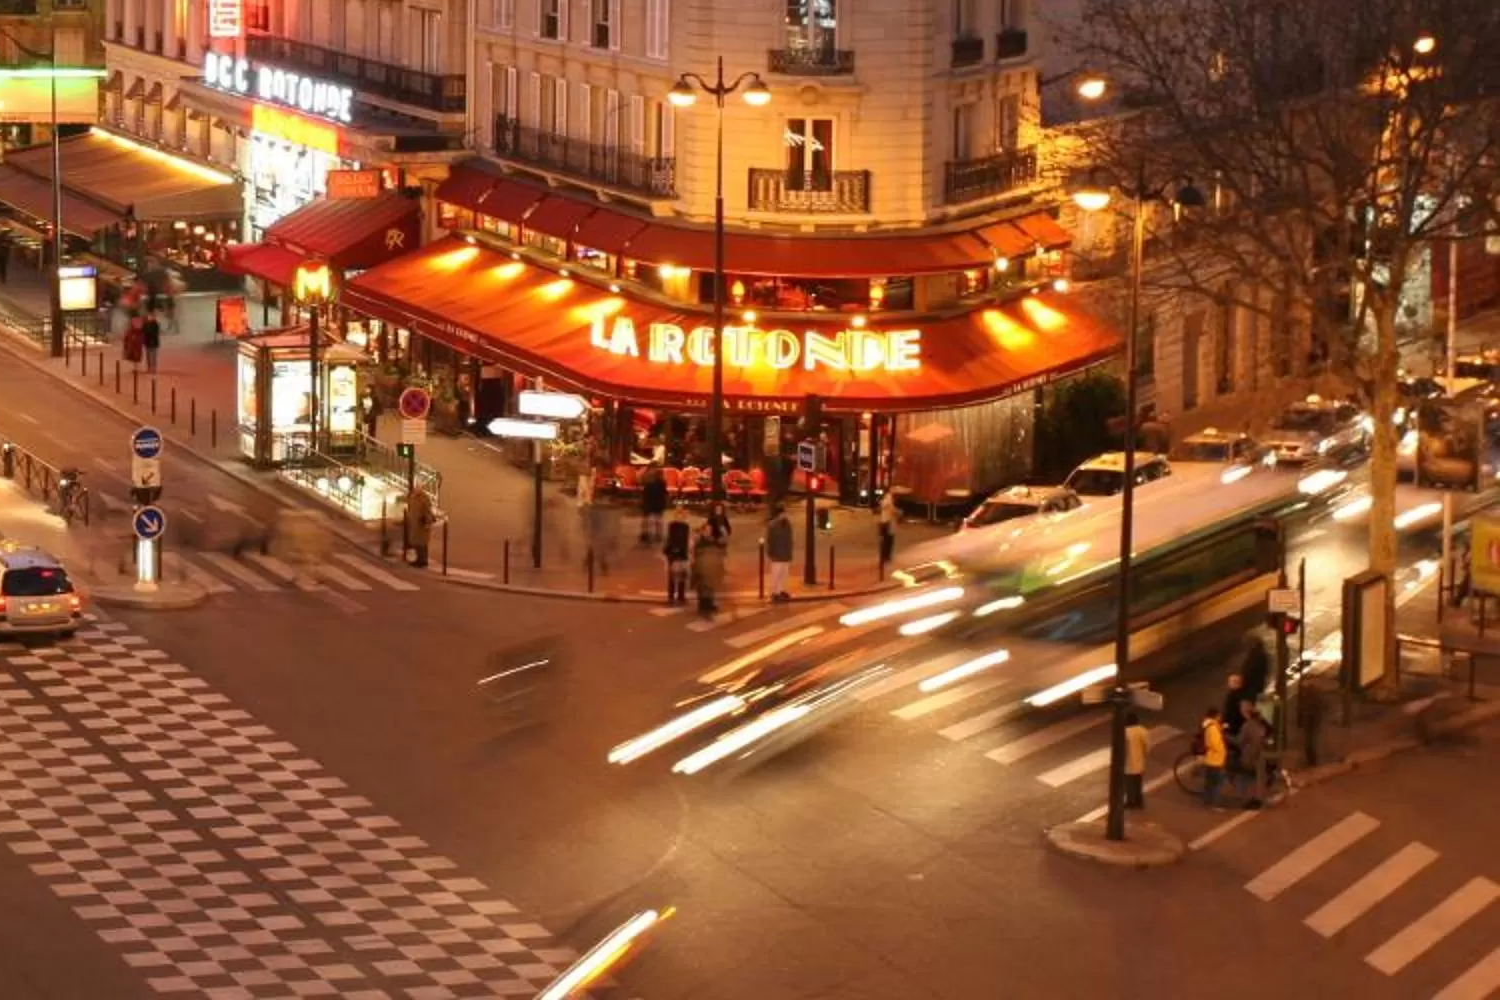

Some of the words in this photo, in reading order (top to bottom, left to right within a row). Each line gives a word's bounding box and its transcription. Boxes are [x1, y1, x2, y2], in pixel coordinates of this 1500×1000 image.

[259, 66, 352, 122] ROTONDE
[590, 305, 639, 358] LA
[649, 322, 922, 372] ROTONDE
